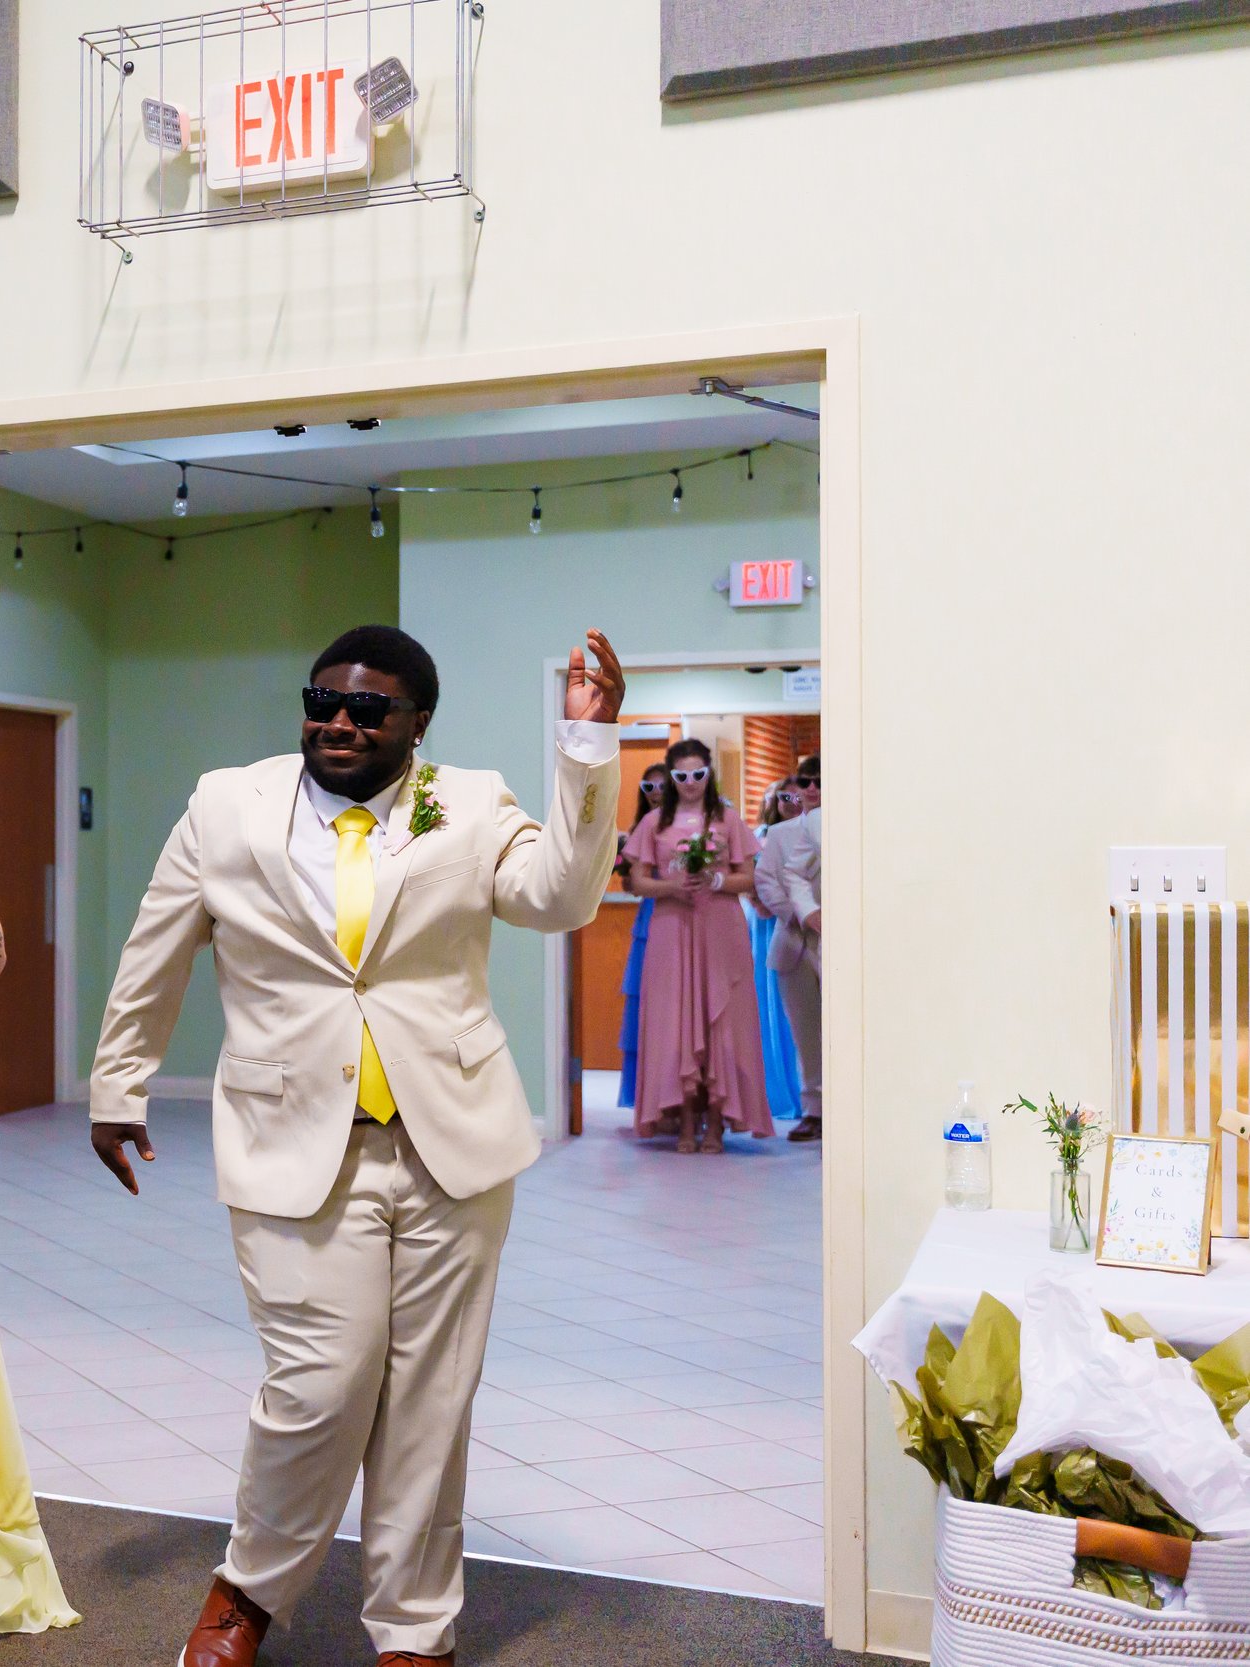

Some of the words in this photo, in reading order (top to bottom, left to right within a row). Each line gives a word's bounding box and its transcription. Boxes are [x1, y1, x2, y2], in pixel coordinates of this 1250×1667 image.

[235, 68, 344, 167] EXIT
[742, 561, 794, 600] EXIT
[1135, 1163, 1183, 1178] Cards
[1151, 1186, 1162, 1198] &
[1134, 1207, 1176, 1221] Gifts
